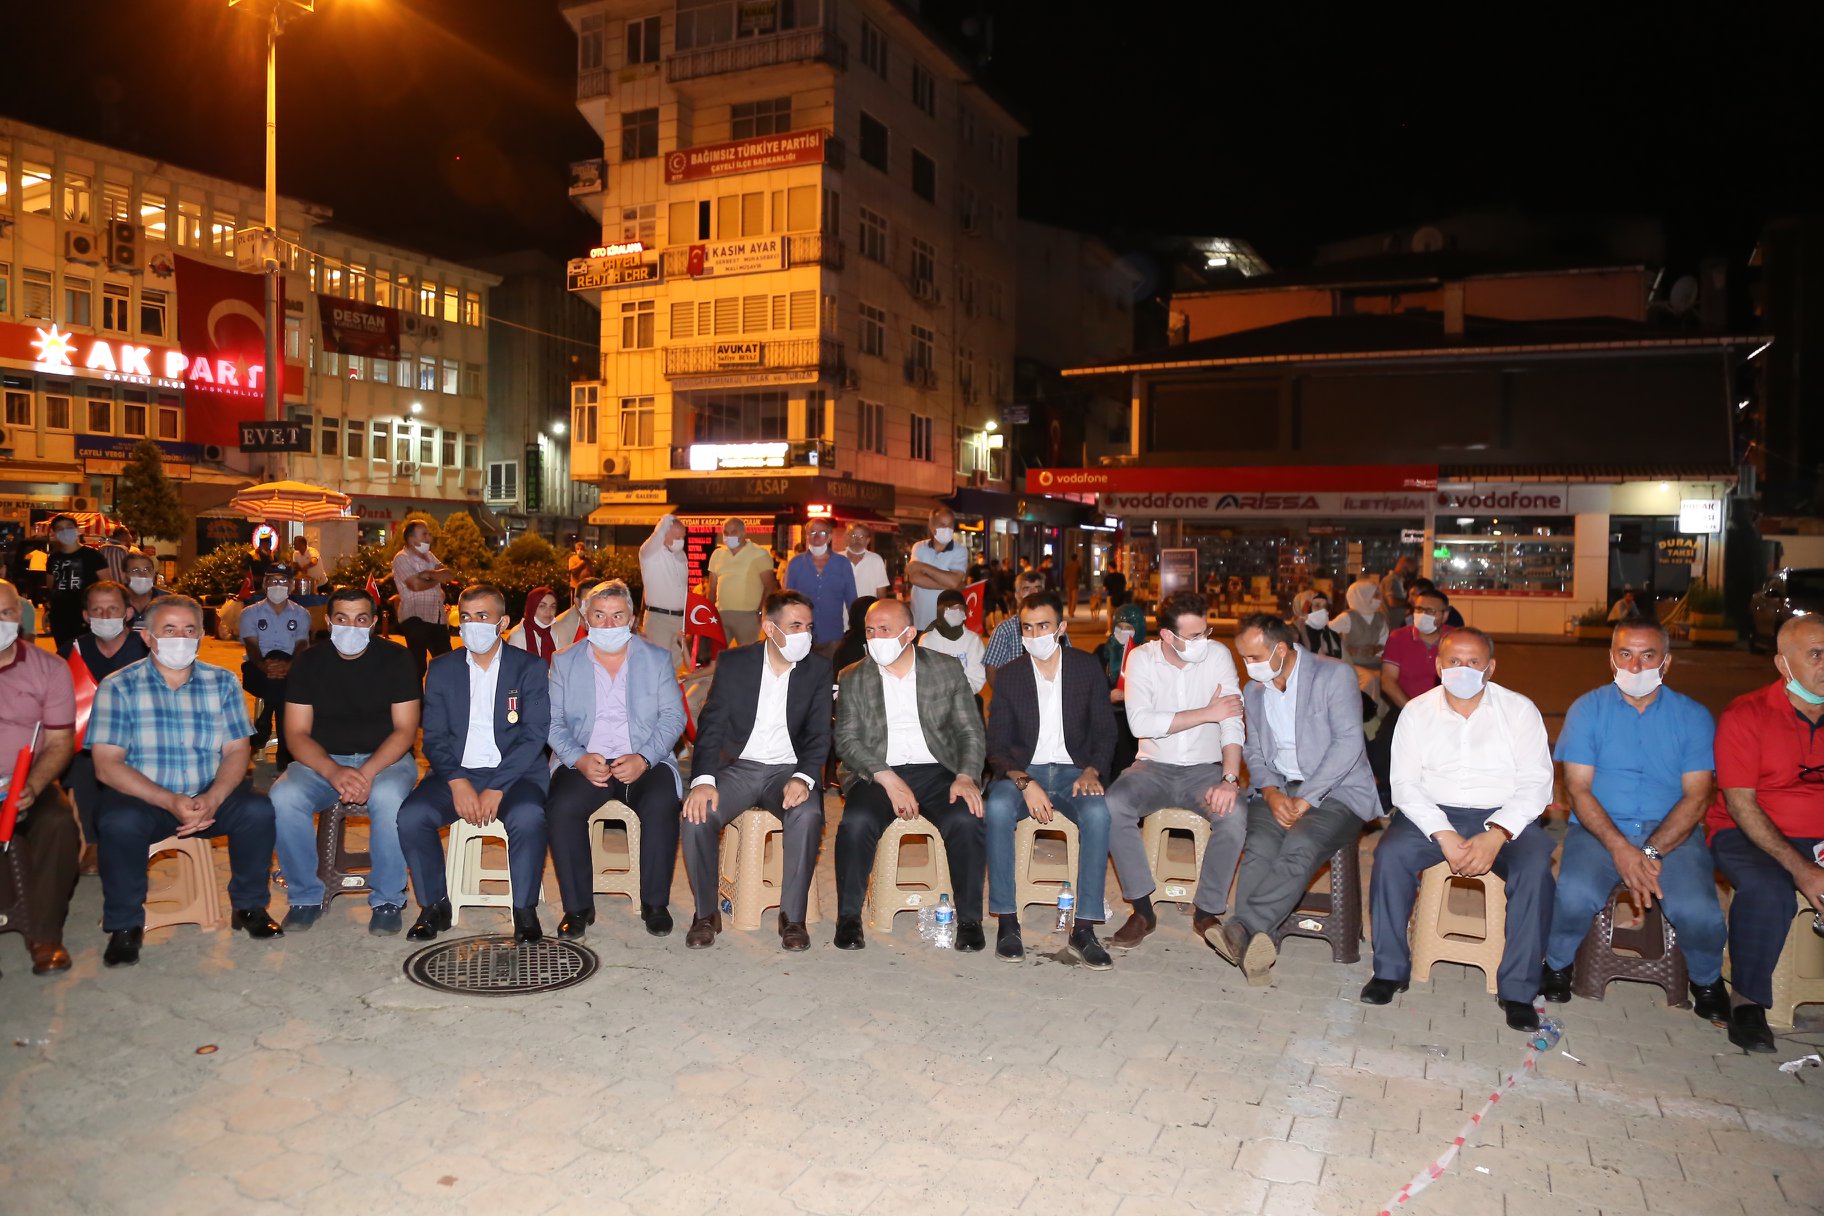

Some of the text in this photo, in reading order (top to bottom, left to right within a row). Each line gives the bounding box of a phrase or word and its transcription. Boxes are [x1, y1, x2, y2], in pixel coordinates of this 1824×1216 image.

[691, 133, 819, 165] BAĞIMSIZ TÜRKİYE PARTİSİ
[711, 162, 735, 173] ÇAYELİ
[736, 159, 752, 169] İLÇE
[590, 247, 606, 258] OTO
[712, 241, 776, 258] KASIM AYAR
[577, 267, 649, 288] RENT A CAR
[333, 309, 385, 328] DESTAN
[716, 344, 759, 354] AVUKAT
[86, 341, 264, 389] AK PART
[242, 427, 299, 445] EVET
[79, 448, 102, 458] ÇAYELİ
[104, 449, 125, 459] VERGİ
[745, 478, 789, 495] KASAP
[1057, 472, 1108, 484] vodafone
[1119, 492, 1208, 510] vodafone
[1455, 491, 1562, 509] vodafone
[701, 518, 720, 526] KASAP
[59, 579, 80, 590] ER
